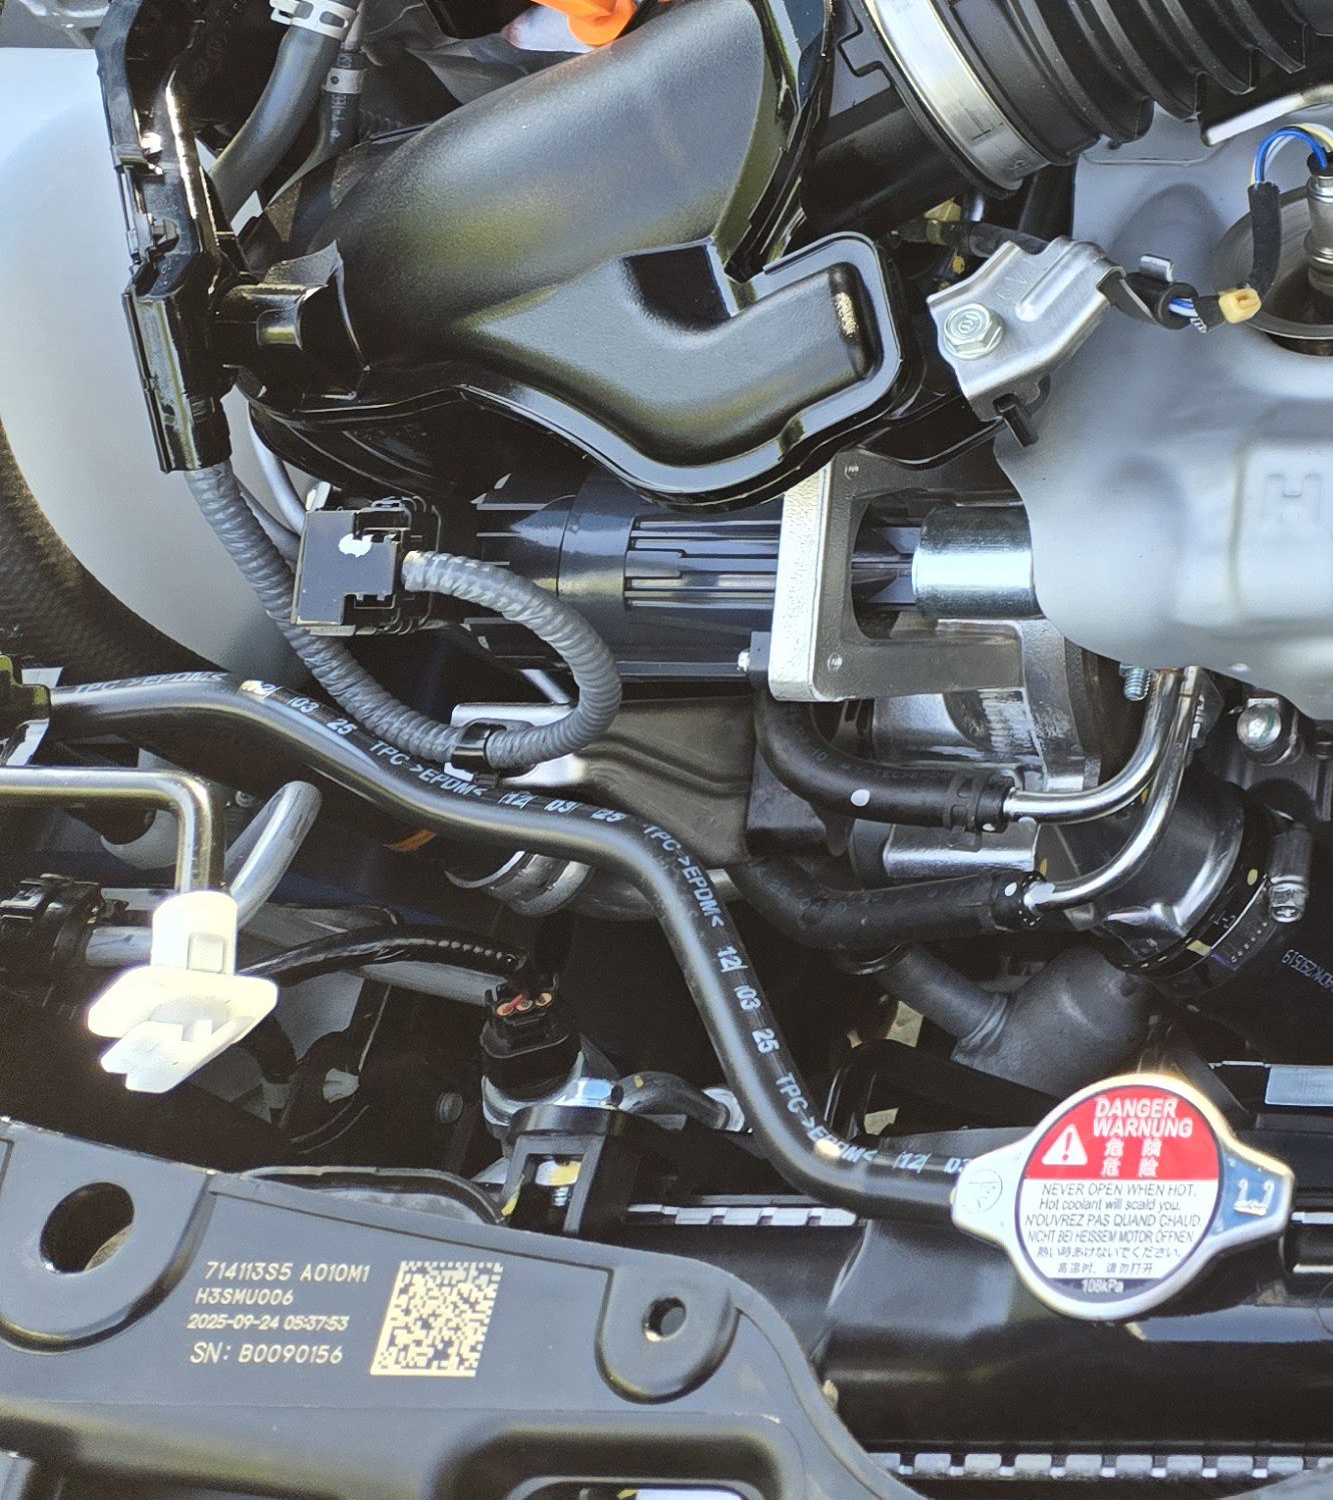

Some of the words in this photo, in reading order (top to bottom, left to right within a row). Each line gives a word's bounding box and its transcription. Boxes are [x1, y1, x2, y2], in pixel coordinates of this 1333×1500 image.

[326, 718, 357, 736] 25
[369, 740, 410, 767] TPC
[643, 823, 681, 852] TPC
[751, 1028, 780, 1054] 25
[776, 1072, 809, 1113] TPC
[1095, 1097, 1178, 1118] DANGER
[1093, 1117, 1194, 1138] WARNUNG
[1042, 1183, 1084, 1196] NEVER
[1088, 1183, 1123, 1196] OPEN
[1127, 1183, 1165, 1196] WHEN
[1169, 1184, 1197, 1197] HOT.
[1039, 1198, 1060, 1211] Hot
[1062, 1198, 1101, 1211] coolant
[1105, 1198, 1123, 1211] will
[1125, 1198, 1156, 1211] scald
[1159, 1200, 1181, 1213] you.
[1025, 1213, 1085, 1227] N'OUVREZ
[1087, 1214, 1111, 1227] PAS
[1113, 1214, 1157, 1228] QUAND
[1028, 1229, 1056, 1243] NICHT
[1057, 1230, 1074, 1243] BEI
[1075, 1230, 1117, 1243] HEISSEM
[1119, 1230, 1153, 1243] MOTOR
[205, 1261, 294, 1281] 714113S5
[300, 1263, 371, 1283] A010M1
[195, 1287, 294, 1306] H3SMU006
[186, 1314, 280, 1331] 2025-09-24
[283, 1315, 350, 1331] 05:37:53
[189, 1341, 232, 1364] SN:
[238, 1344, 343, 1364] B0090156
